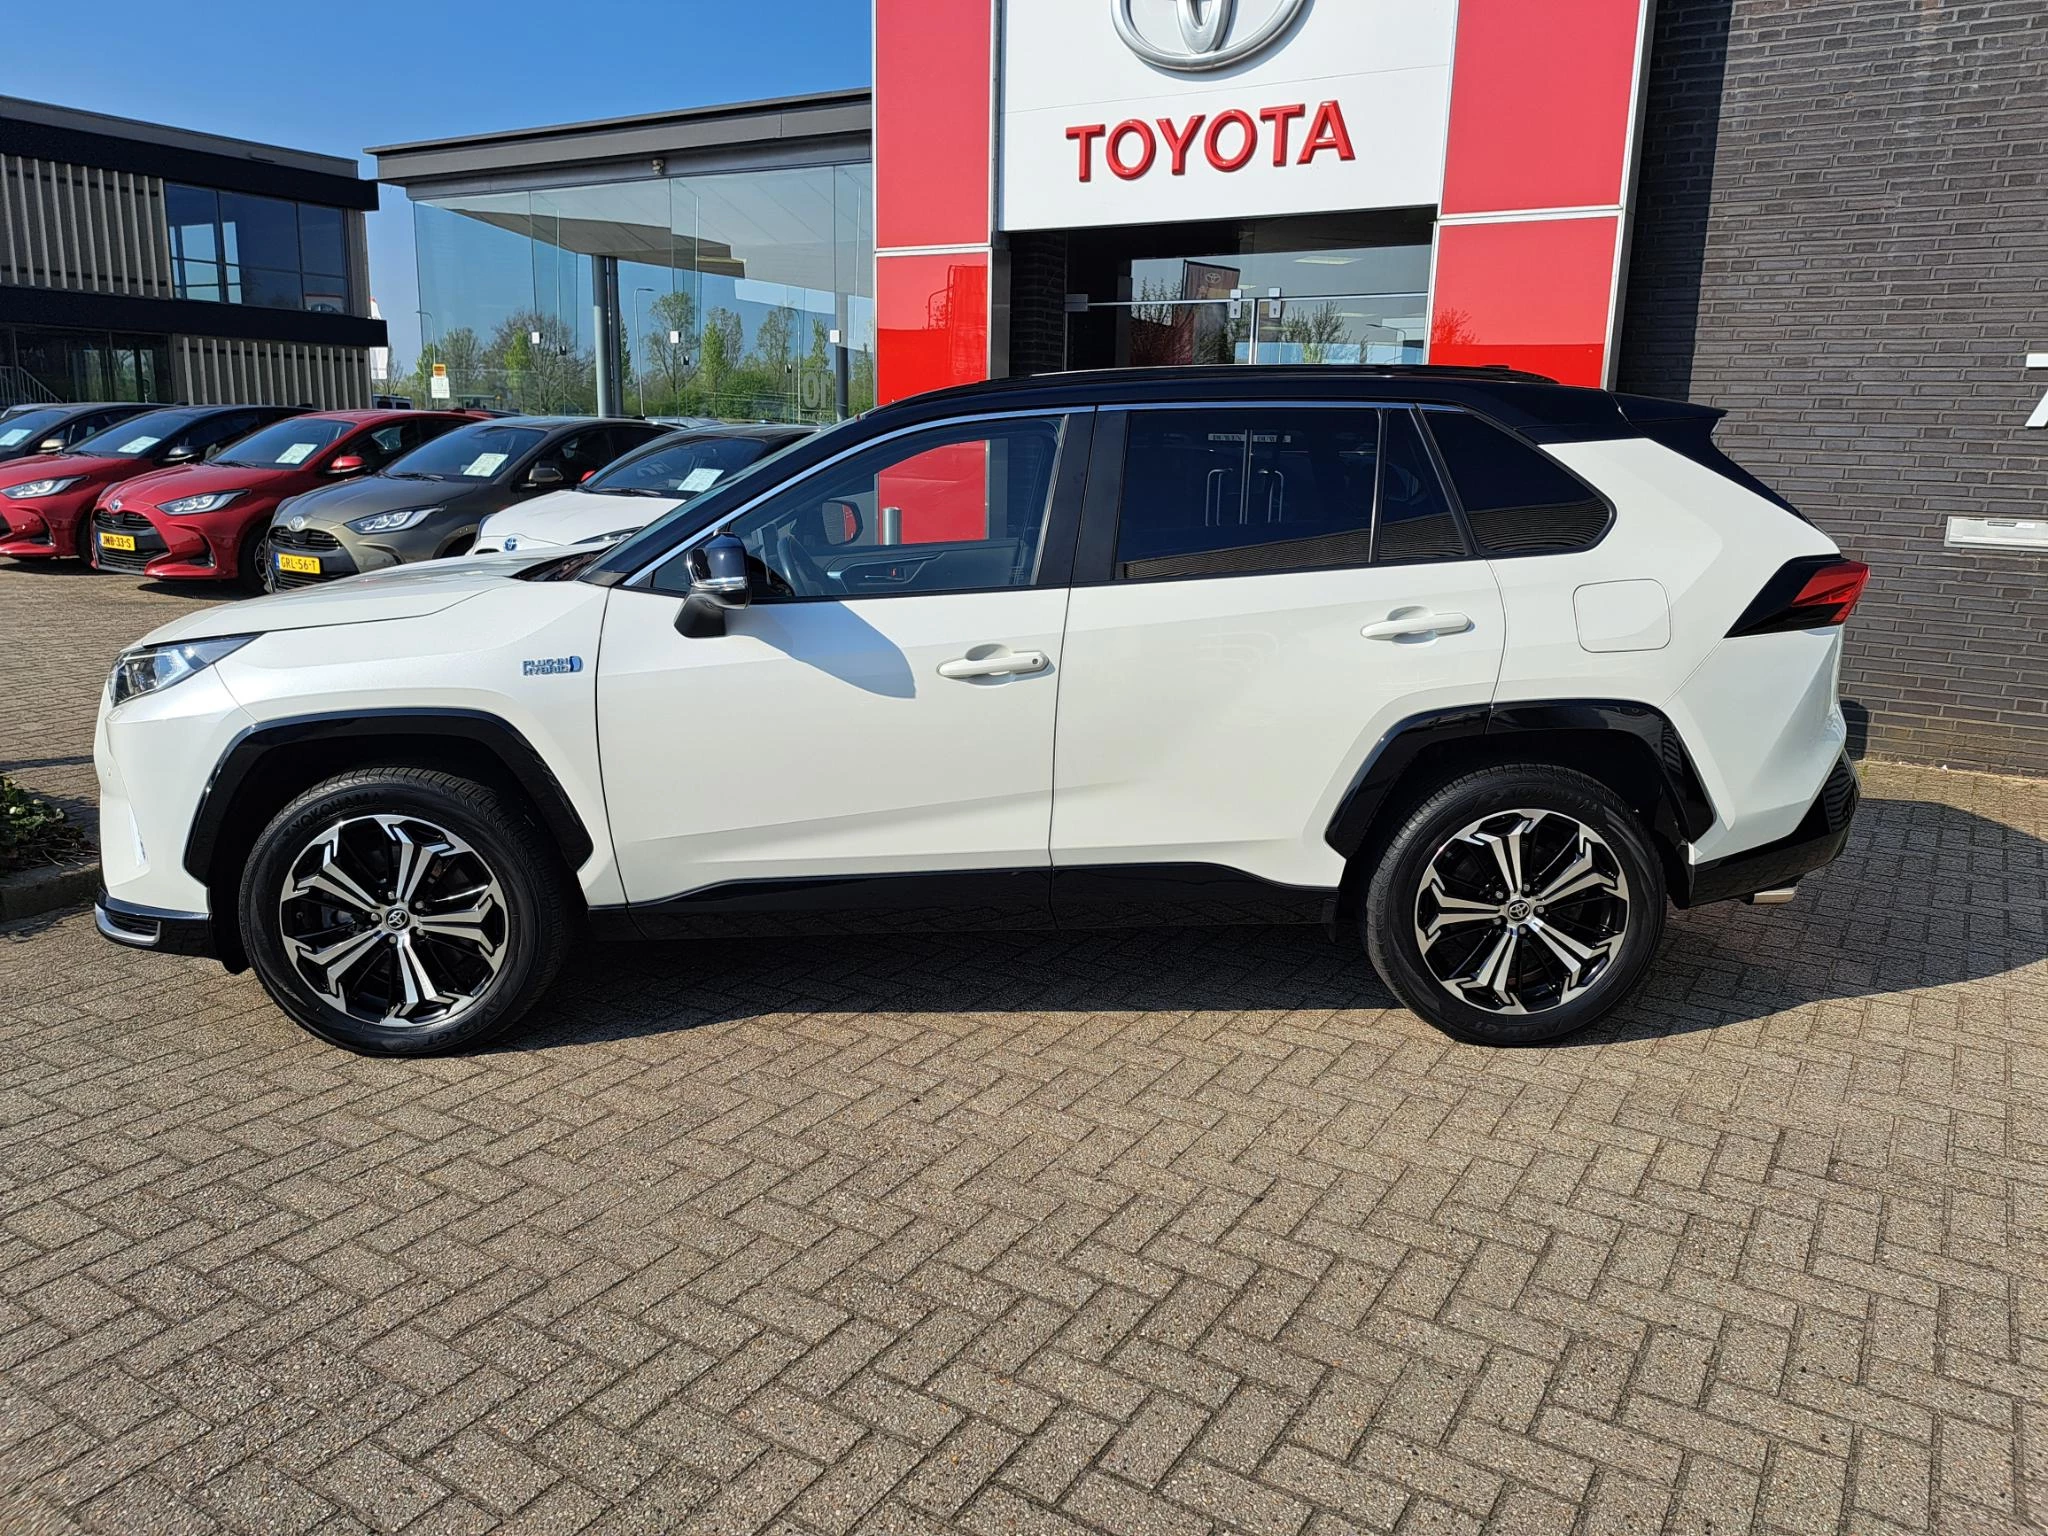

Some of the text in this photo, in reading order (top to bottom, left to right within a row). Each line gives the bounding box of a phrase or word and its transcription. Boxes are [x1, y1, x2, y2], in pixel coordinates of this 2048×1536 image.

[1065, 99, 1356, 183] TOYOTA
[281, 556, 317, 571] GRL-56-T
[523, 657, 569, 668] PLUG-IN
